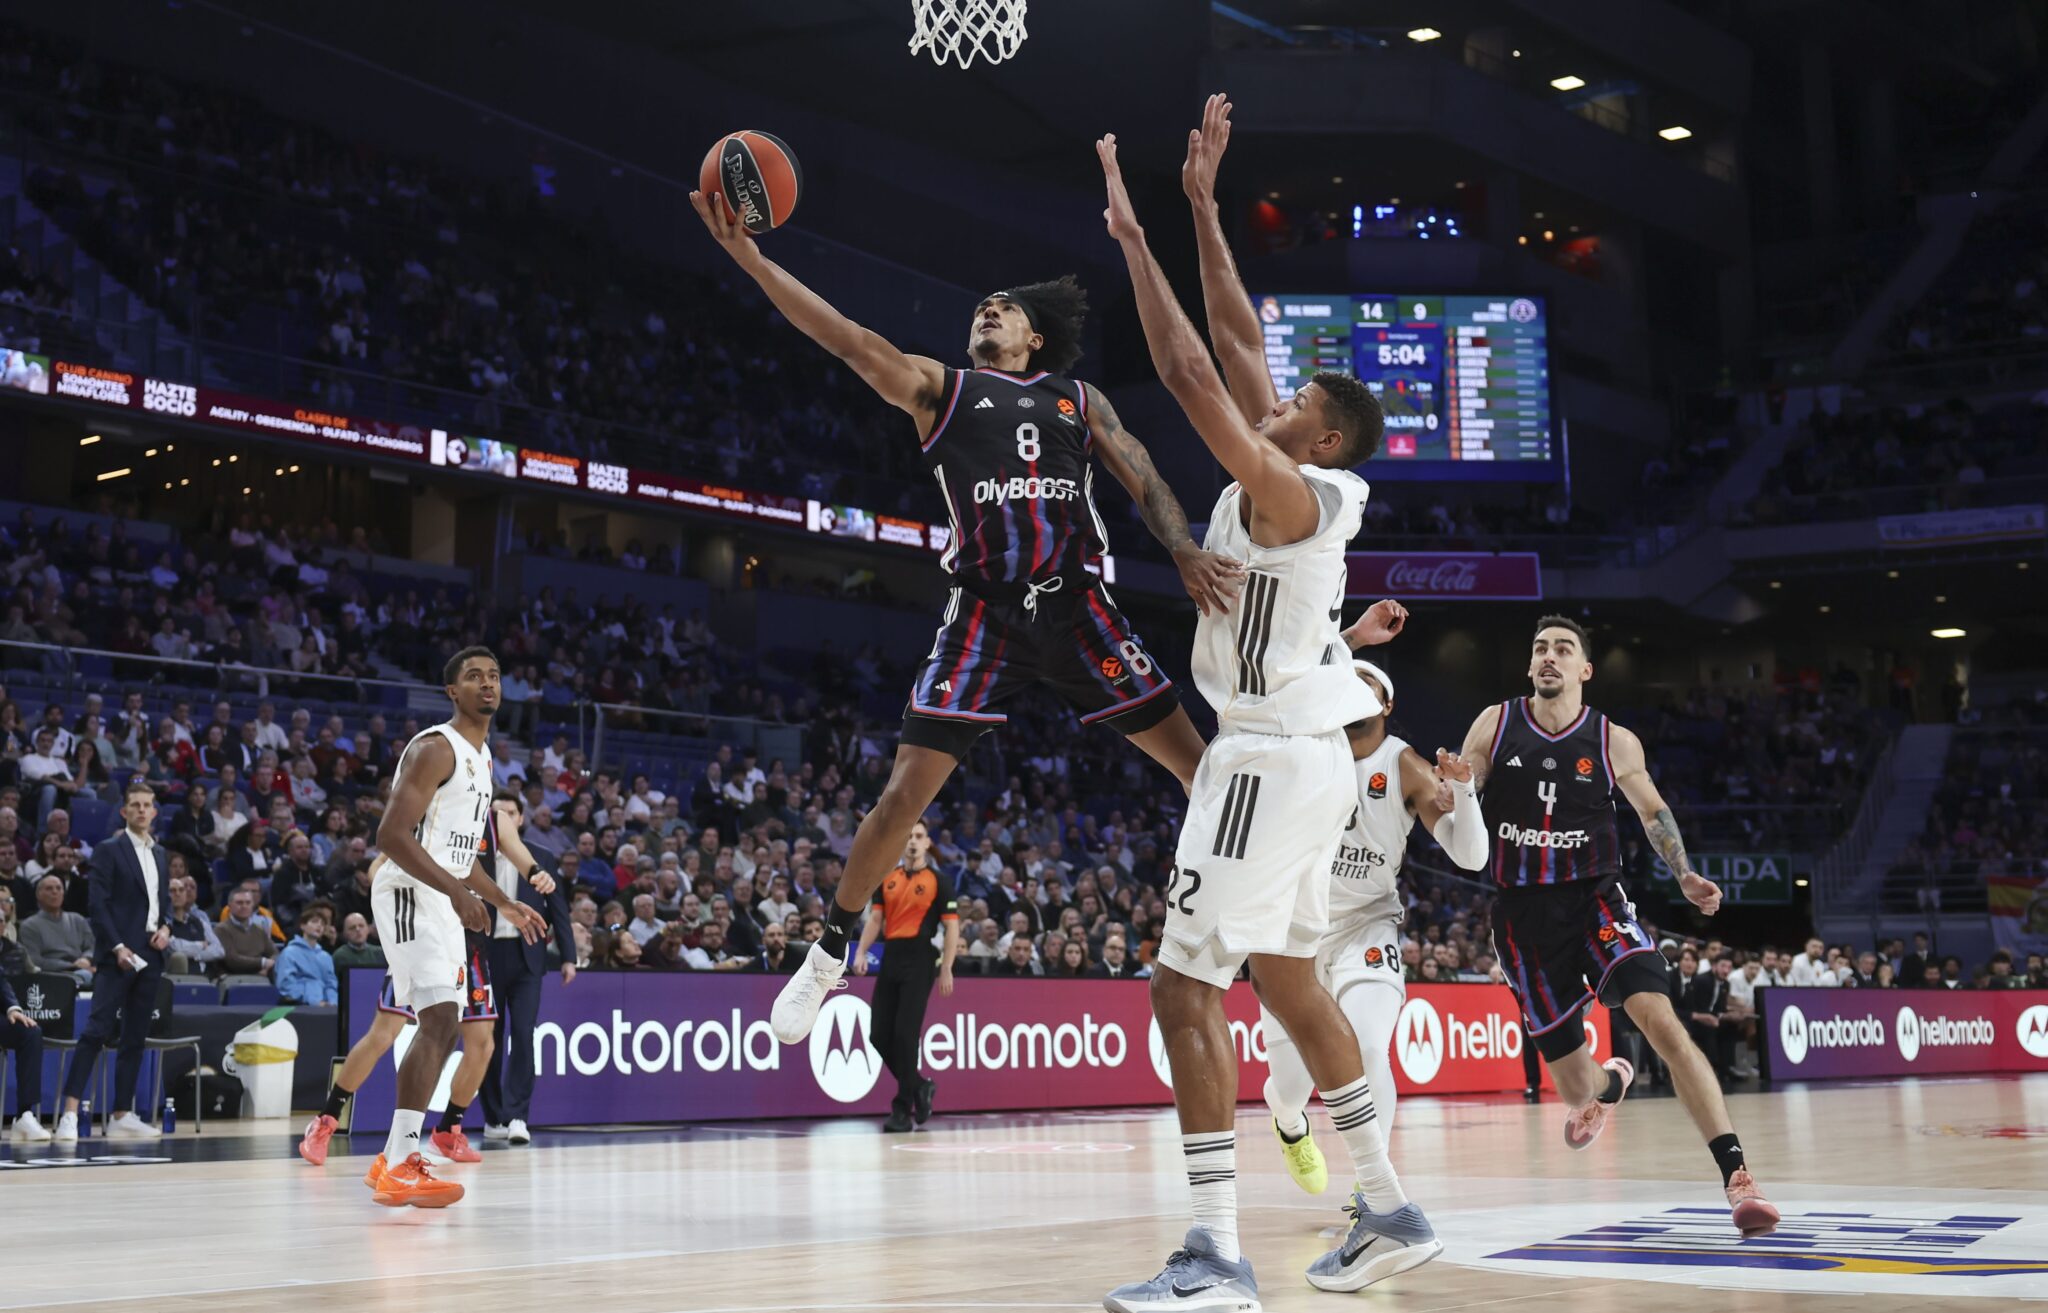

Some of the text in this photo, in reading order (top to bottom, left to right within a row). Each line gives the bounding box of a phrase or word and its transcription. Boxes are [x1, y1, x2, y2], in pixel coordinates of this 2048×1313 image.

[725, 153, 763, 225] SPALDING
[1360, 302, 1383, 320] 14
[1413, 303, 1427, 321] 9
[1378, 344, 1426, 365] 5:04
[144, 378, 197, 402] HAZTE
[143, 393, 197, 416] SOCIO
[209, 405, 249, 423] AGILITY
[1383, 413, 1439, 430] ALTAS 0
[1016, 422, 1041, 462] 8
[588, 461, 629, 481] HAZTE
[587, 474, 629, 494] SOCIO
[974, 477, 1078, 505] OlyBOOST
[1120, 640, 1152, 676] 8
[1538, 781, 1557, 815] 4
[1498, 822, 1586, 848] OlyBOOST
[1331, 861, 1370, 880] BETTER
[1652, 856, 1780, 880] SLIDA
[1384, 944, 1400, 973] 8
[917, 1013, 1127, 1072] ellomoto
[1809, 1013, 1885, 1048] motorola
[1919, 1015, 1995, 1046] hellomoto
